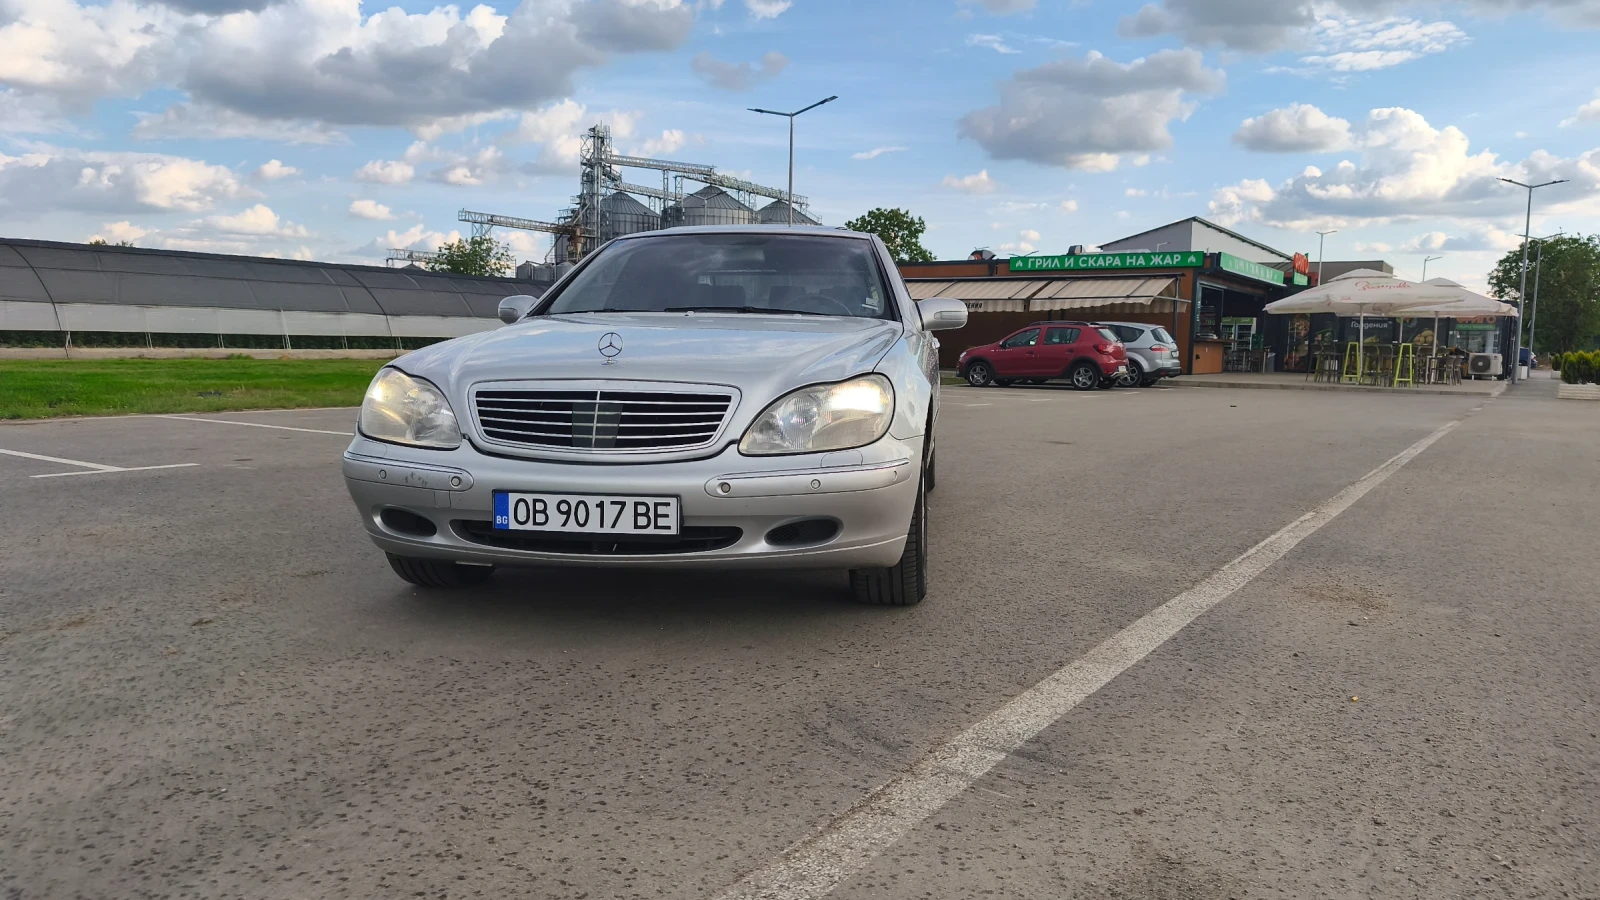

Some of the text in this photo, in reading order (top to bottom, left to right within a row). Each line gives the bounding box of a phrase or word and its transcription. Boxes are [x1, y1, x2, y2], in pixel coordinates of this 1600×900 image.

[1027, 253, 1182, 269] ГРИЛ И СКАРА НА ЖАР
[496, 515, 508, 525] BG
[513, 498, 672, 530] OB 9017 BE
